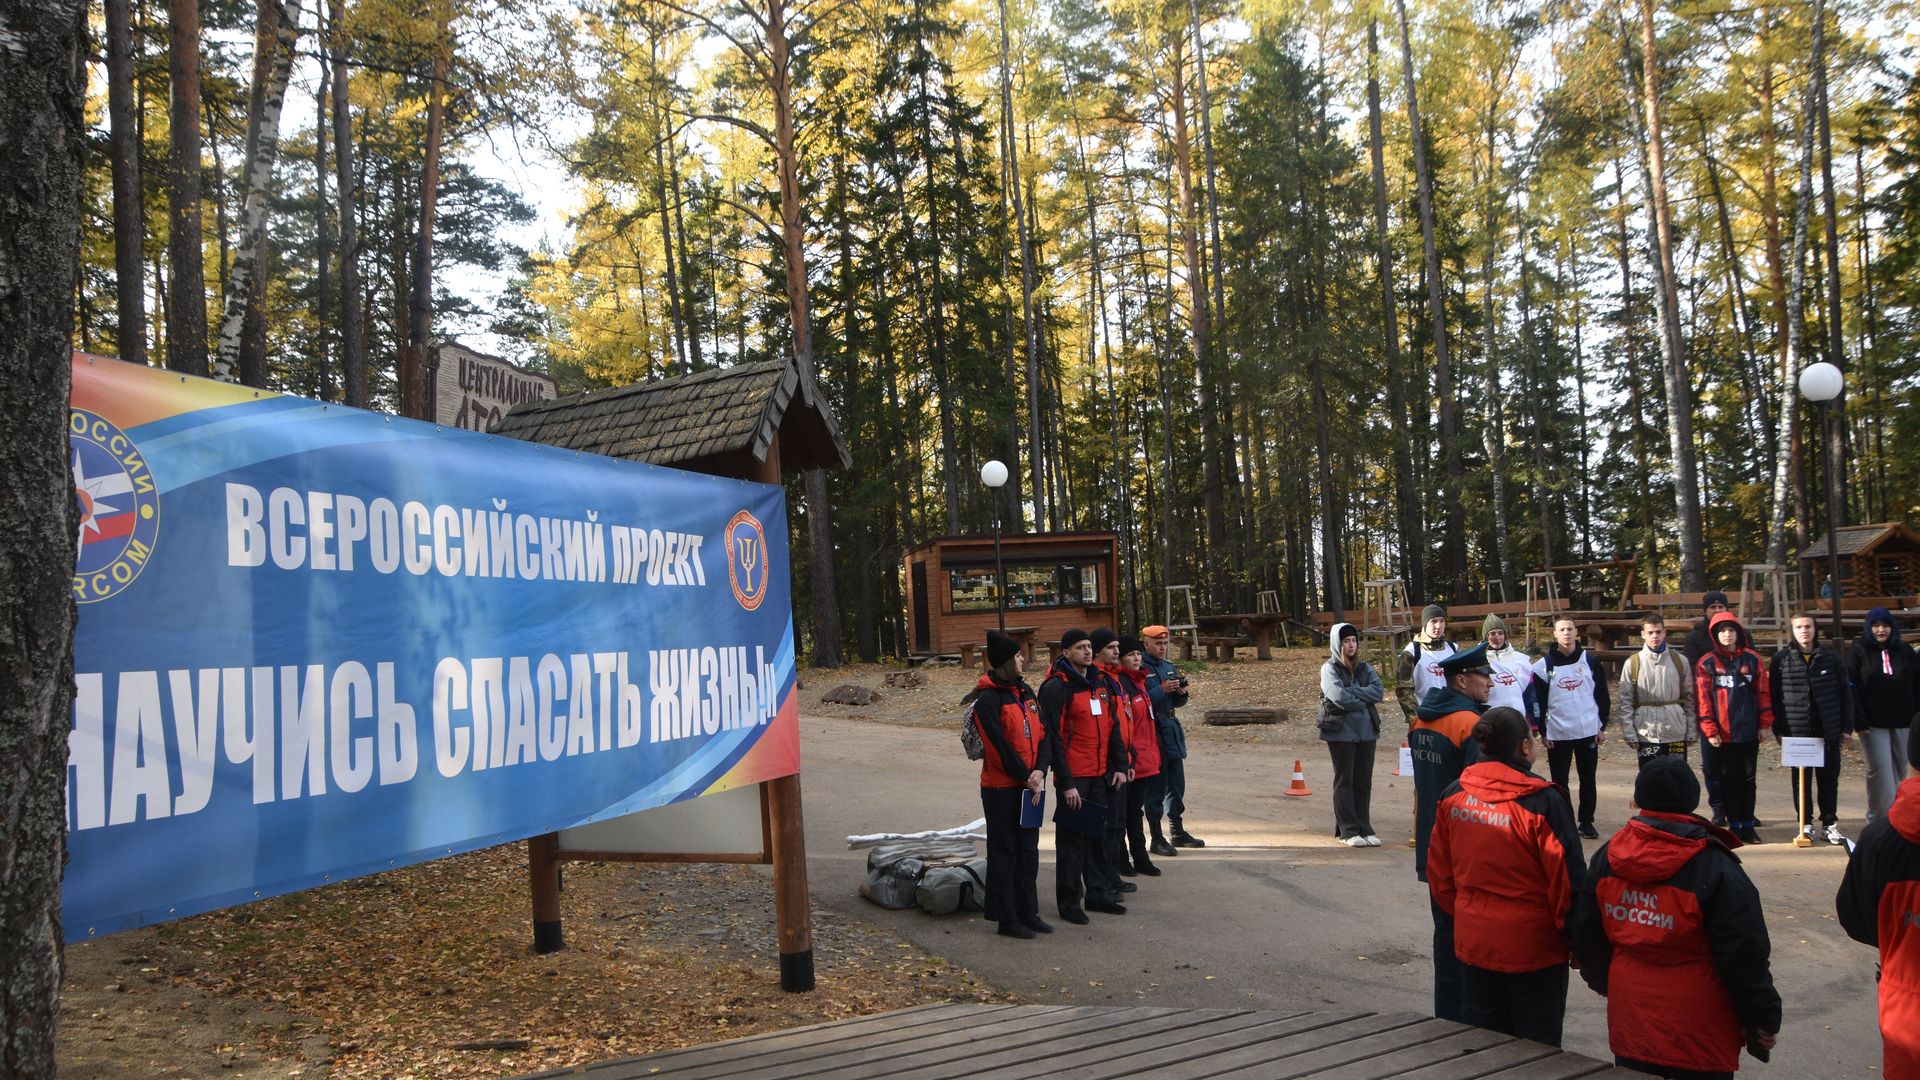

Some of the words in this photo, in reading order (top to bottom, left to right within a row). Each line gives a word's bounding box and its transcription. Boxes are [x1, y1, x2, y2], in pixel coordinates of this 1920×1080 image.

[70, 412, 154, 495] ОССИИ
[226, 482, 606, 581] ВСЕРОССИЙСКИЙ
[611, 525, 706, 586] ПРОЕКТ
[73, 539, 151, 599] RCOM
[433, 651, 641, 778] СПАСАТЬ
[1451, 806, 1510, 828] РОССИИ
[1605, 903, 1675, 930] РОССИИ
[1621, 889, 1658, 909] МЧС
